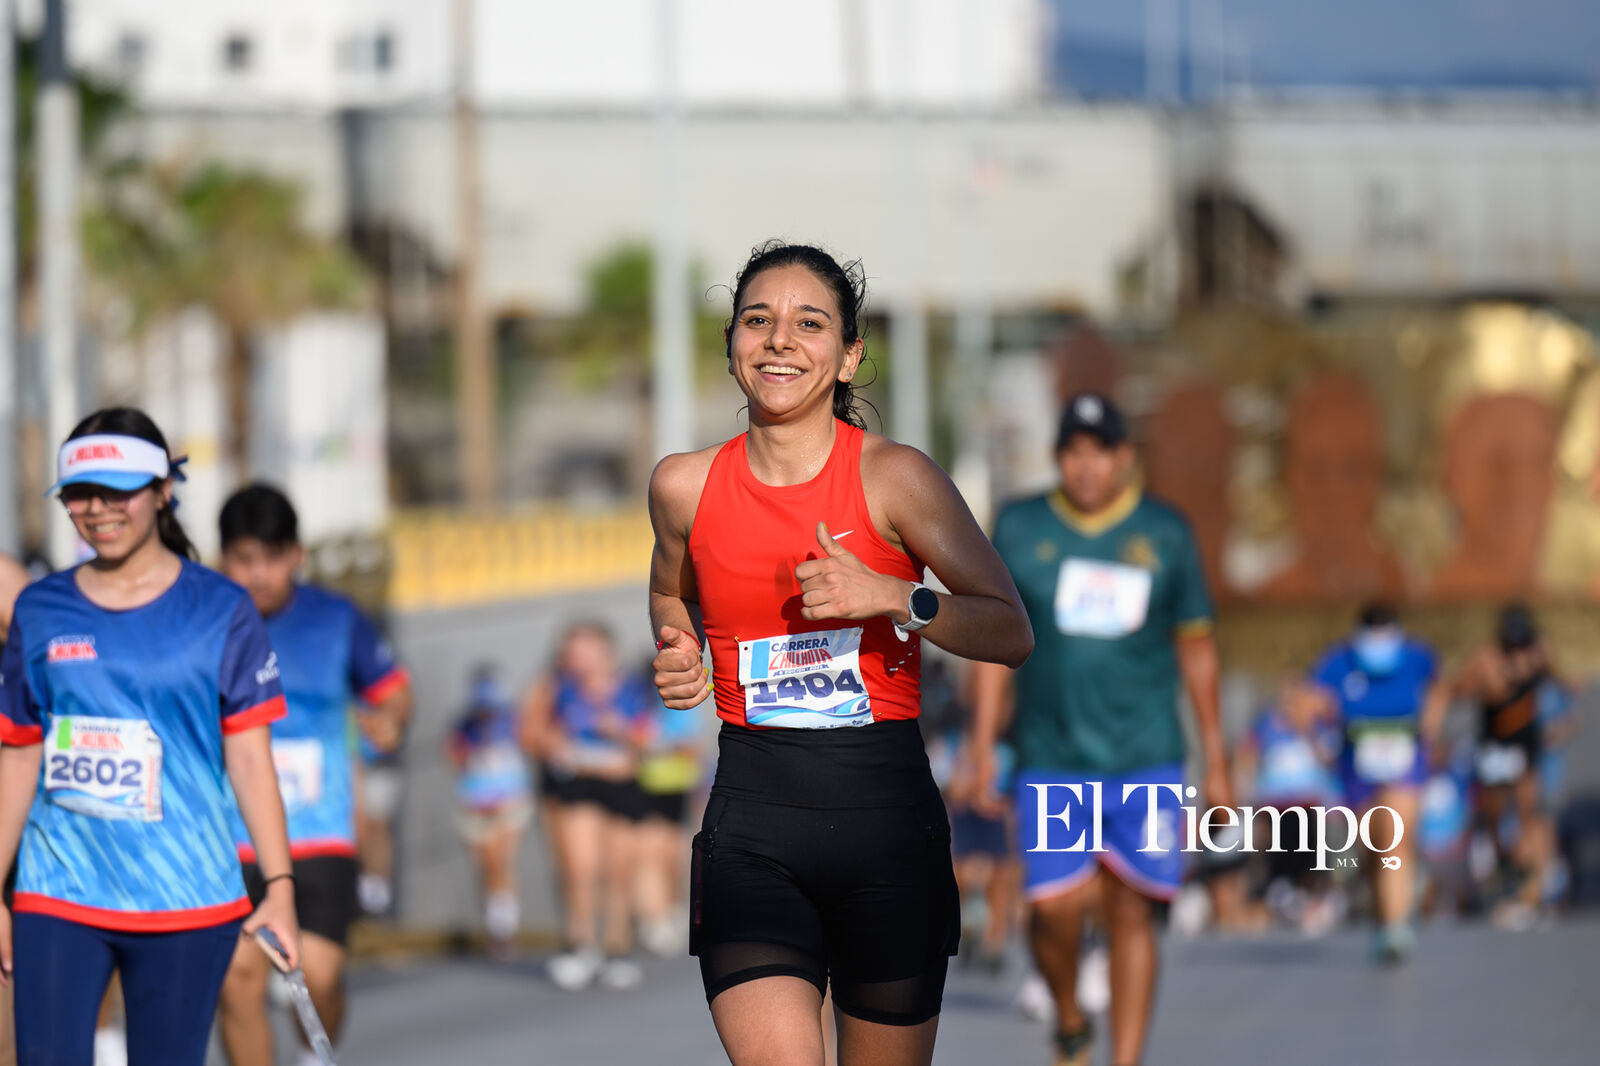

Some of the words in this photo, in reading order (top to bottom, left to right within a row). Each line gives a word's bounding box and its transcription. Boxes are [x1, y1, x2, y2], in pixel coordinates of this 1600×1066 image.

[771, 638, 829, 652] CARRERA
[752, 669, 864, 703] 1404
[51, 755, 142, 786] 2602
